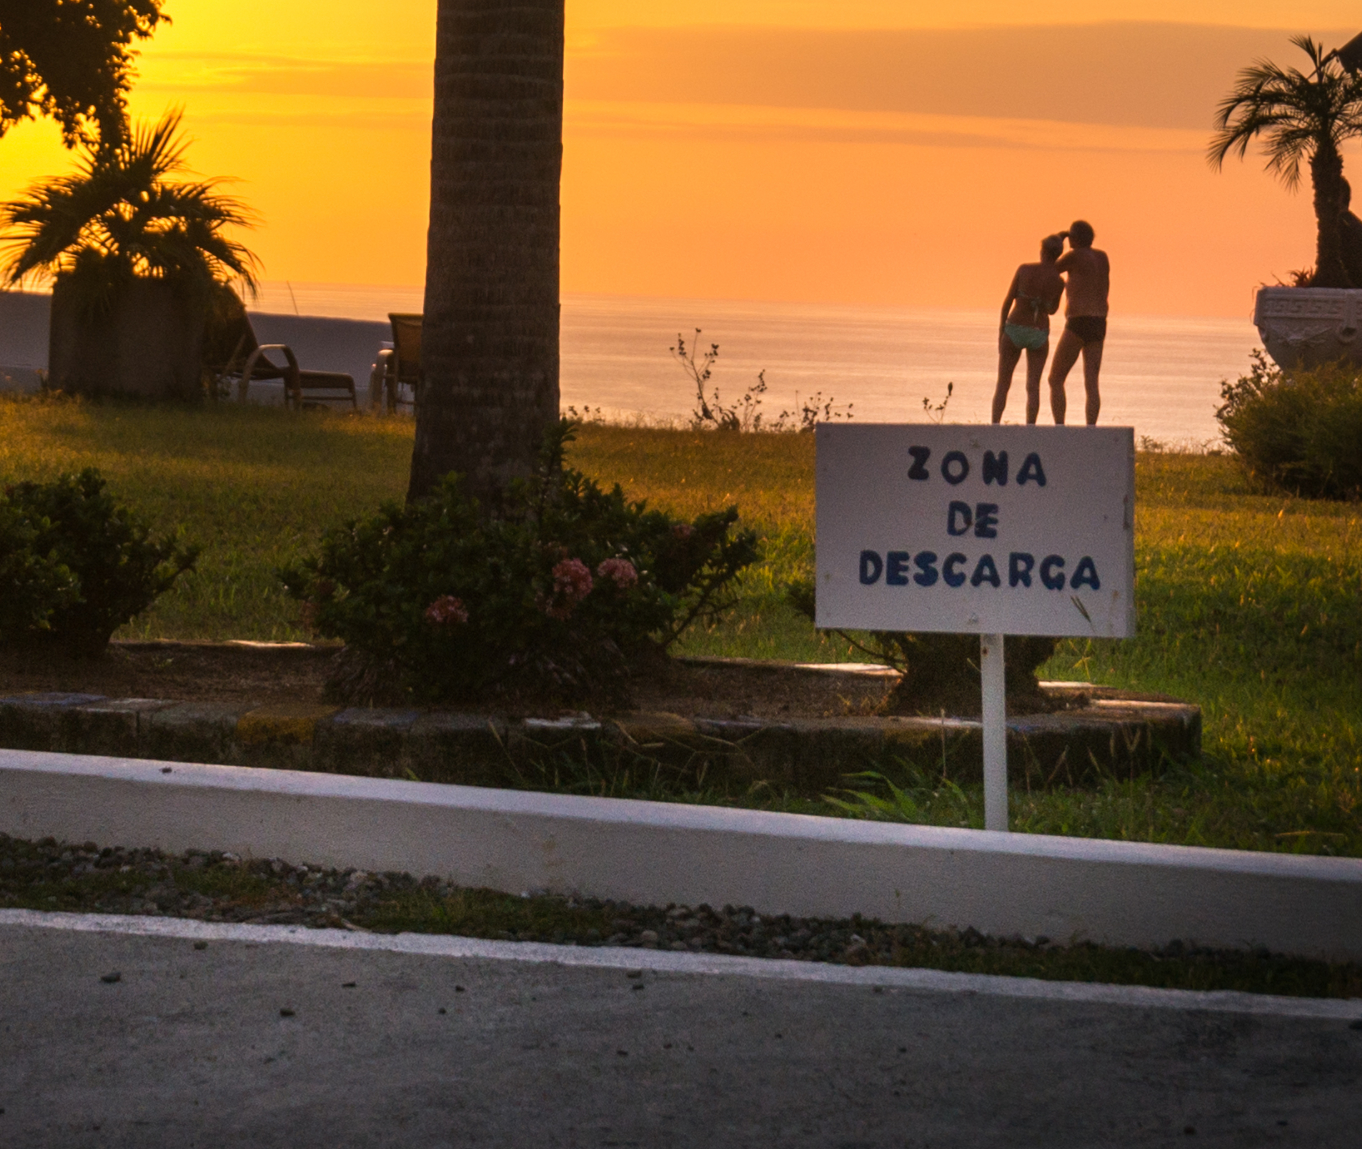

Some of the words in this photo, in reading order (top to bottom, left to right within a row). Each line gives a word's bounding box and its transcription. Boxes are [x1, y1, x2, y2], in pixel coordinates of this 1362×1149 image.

[907, 445, 1047, 487] ZONA
[946, 500, 999, 539] DE
[859, 549, 1101, 591] DESCARGA
